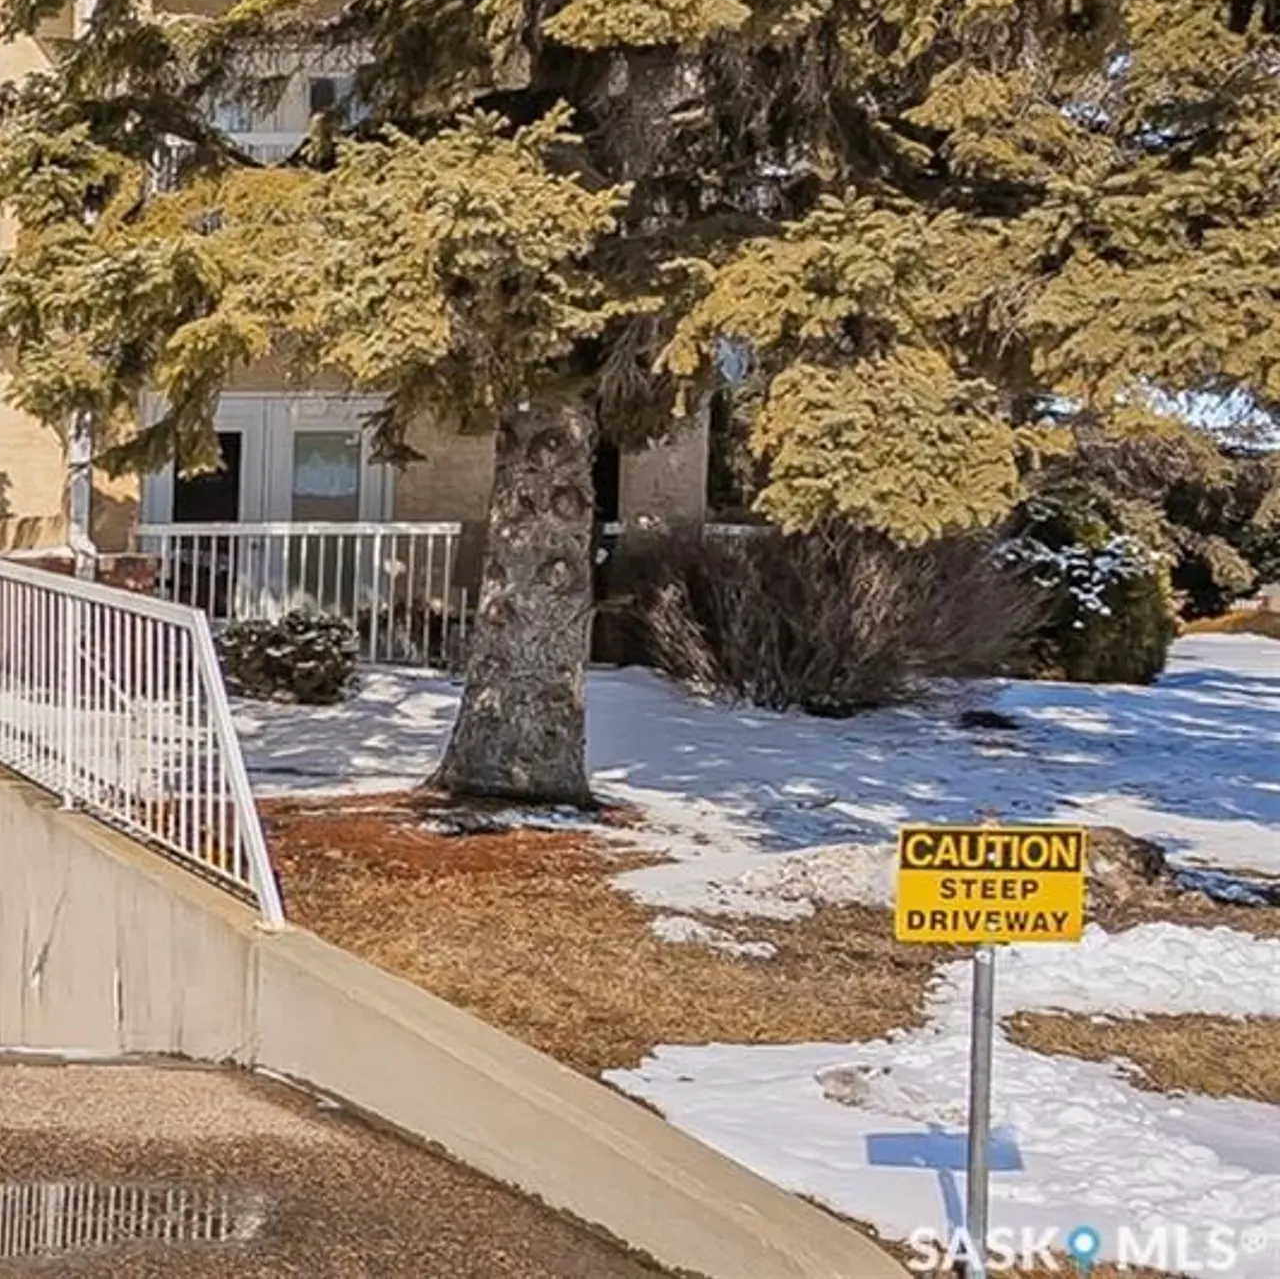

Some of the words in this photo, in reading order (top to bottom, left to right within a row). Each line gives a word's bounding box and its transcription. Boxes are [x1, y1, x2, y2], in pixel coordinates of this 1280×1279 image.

[905, 833, 1078, 868] CAUTION
[940, 878, 1039, 900] STEEP
[907, 909, 1069, 932] DRIVEWAY
